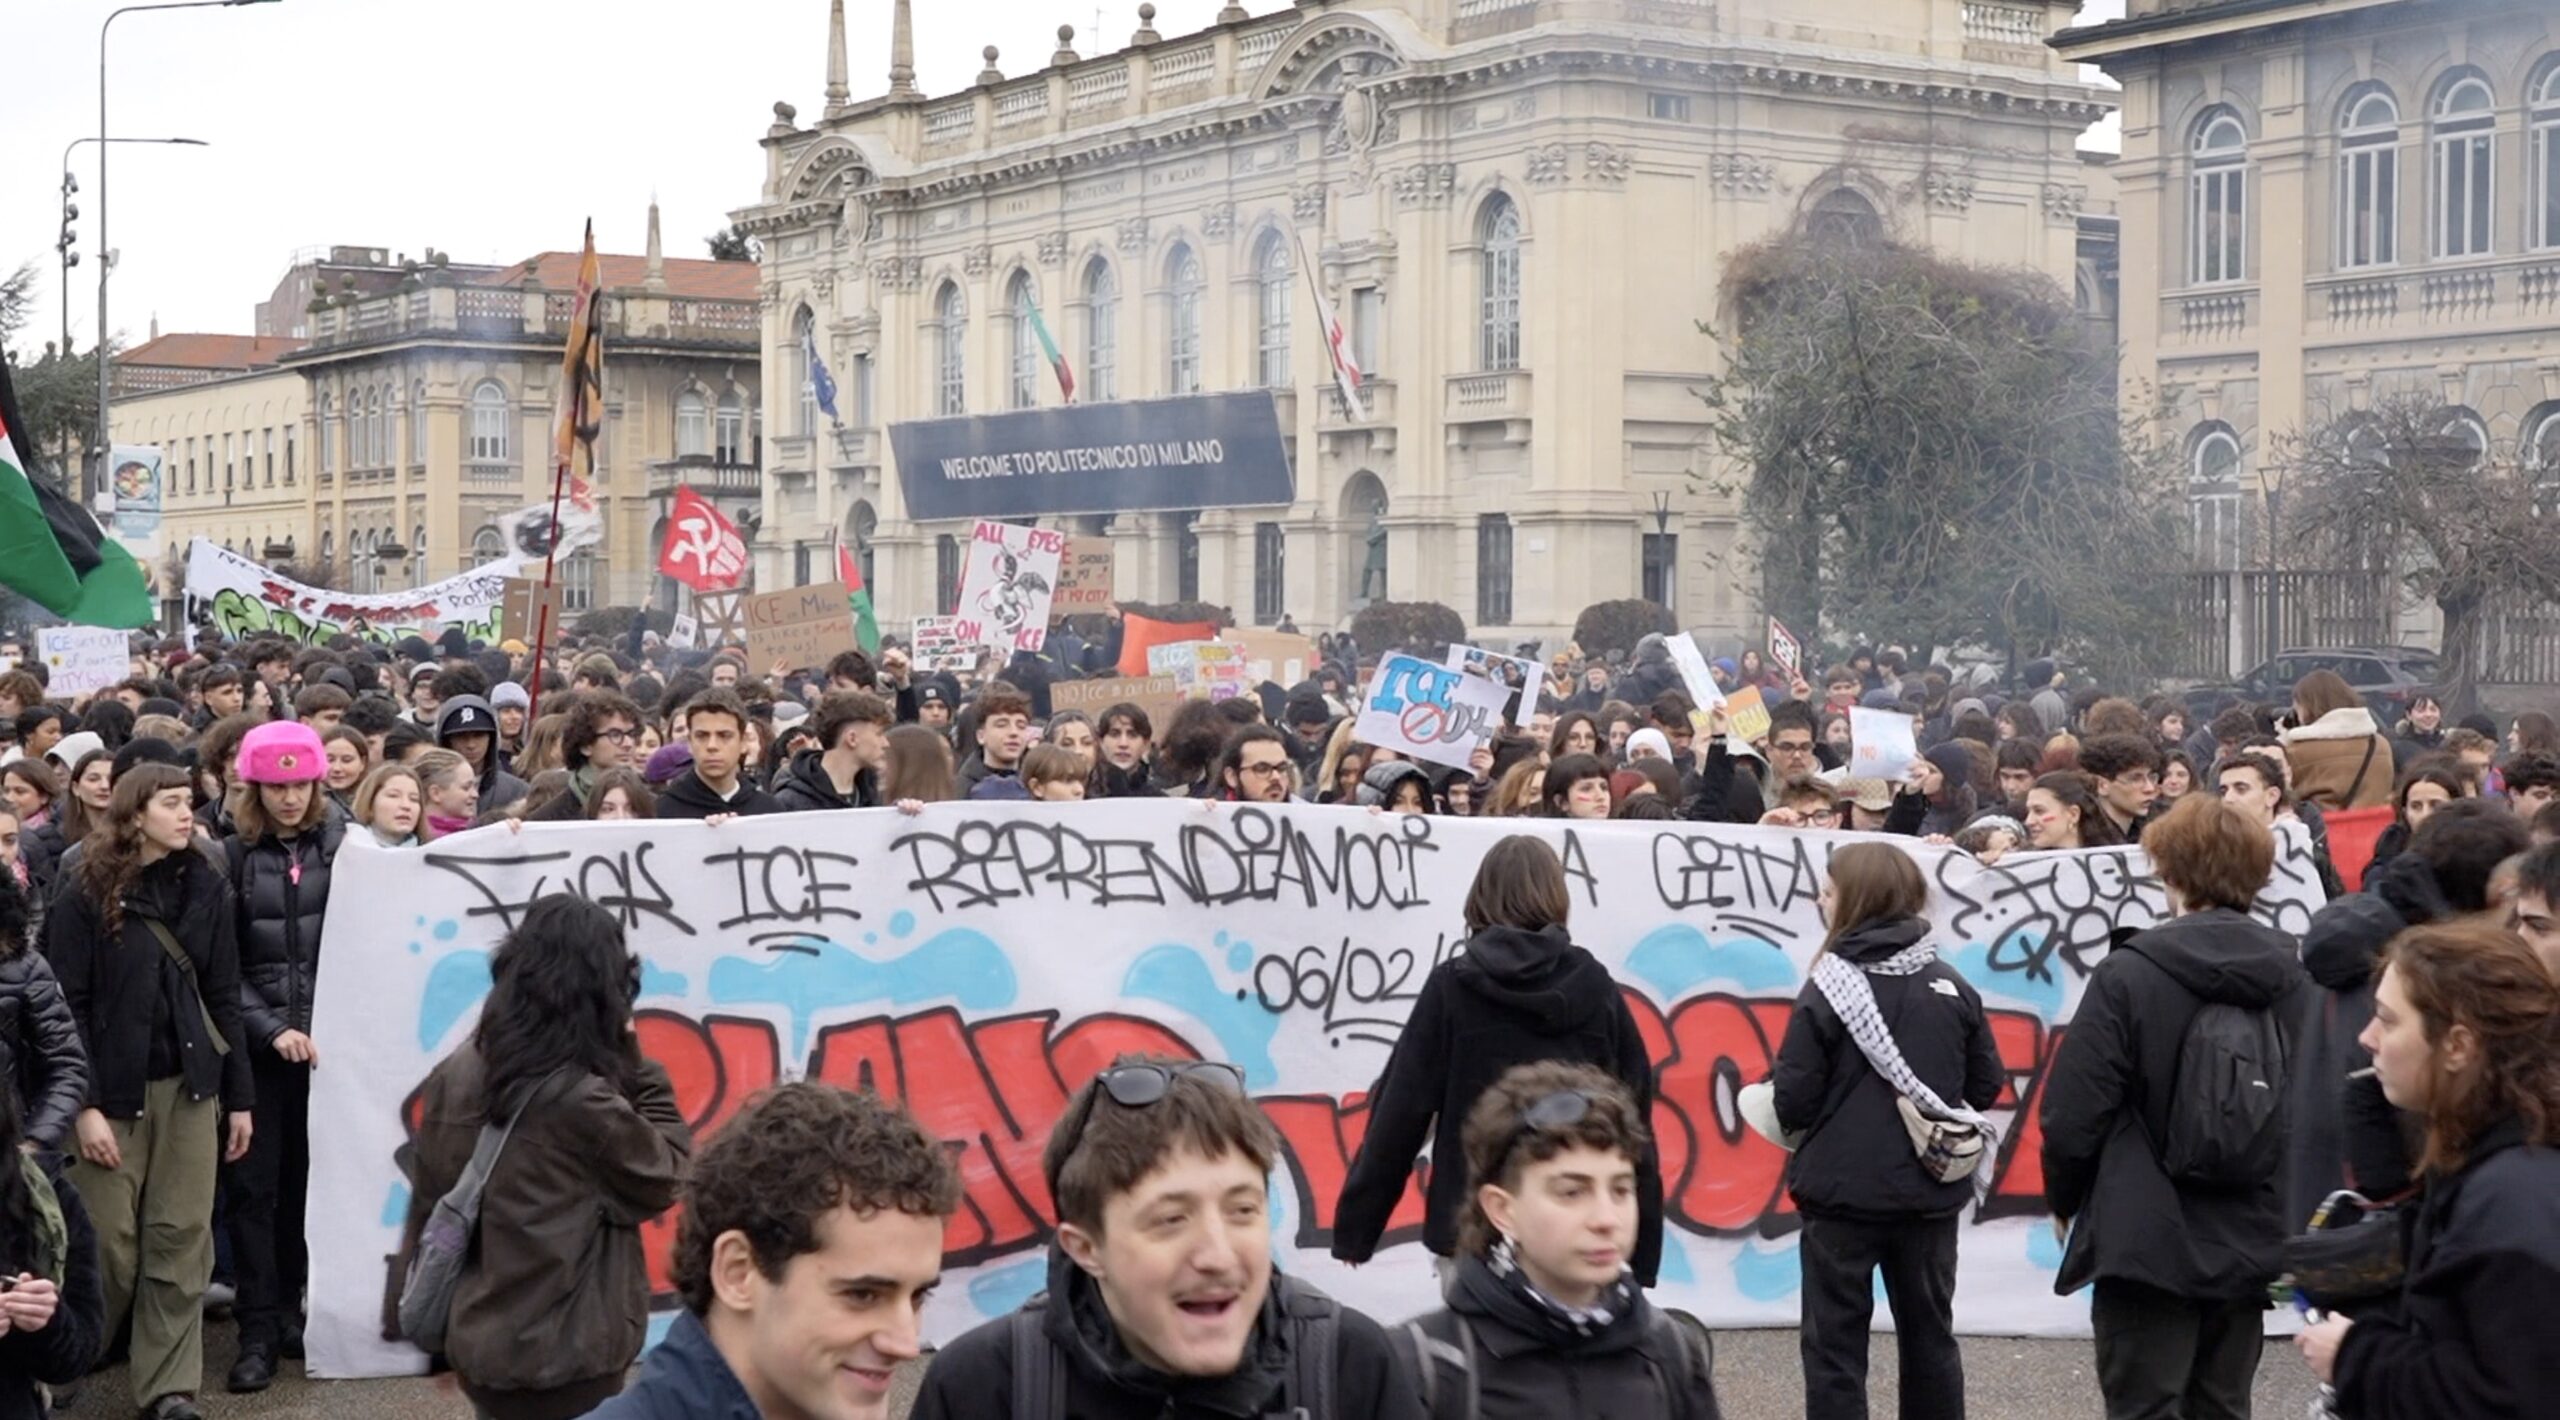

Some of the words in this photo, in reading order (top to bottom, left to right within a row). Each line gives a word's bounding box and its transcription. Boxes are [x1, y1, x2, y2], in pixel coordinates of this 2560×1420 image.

[940, 457, 1013, 480] WELCOME
[1012, 452, 1035, 475] TO
[1037, 444, 1138, 474] POLITECNICO
[1138, 443, 1158, 467] DI
[1158, 439, 1224, 466] MILANO
[974, 522, 1004, 544] ALL
[1028, 530, 1062, 554] EYES
[748, 596, 783, 628] ICE
[46, 635, 73, 652] ICE
[955, 619, 981, 642] ON
[1014, 629, 1043, 651] ICE
[1371, 656, 1463, 716] ICE
[424, 841, 697, 936] FCK
[704, 845, 861, 930] ICE
